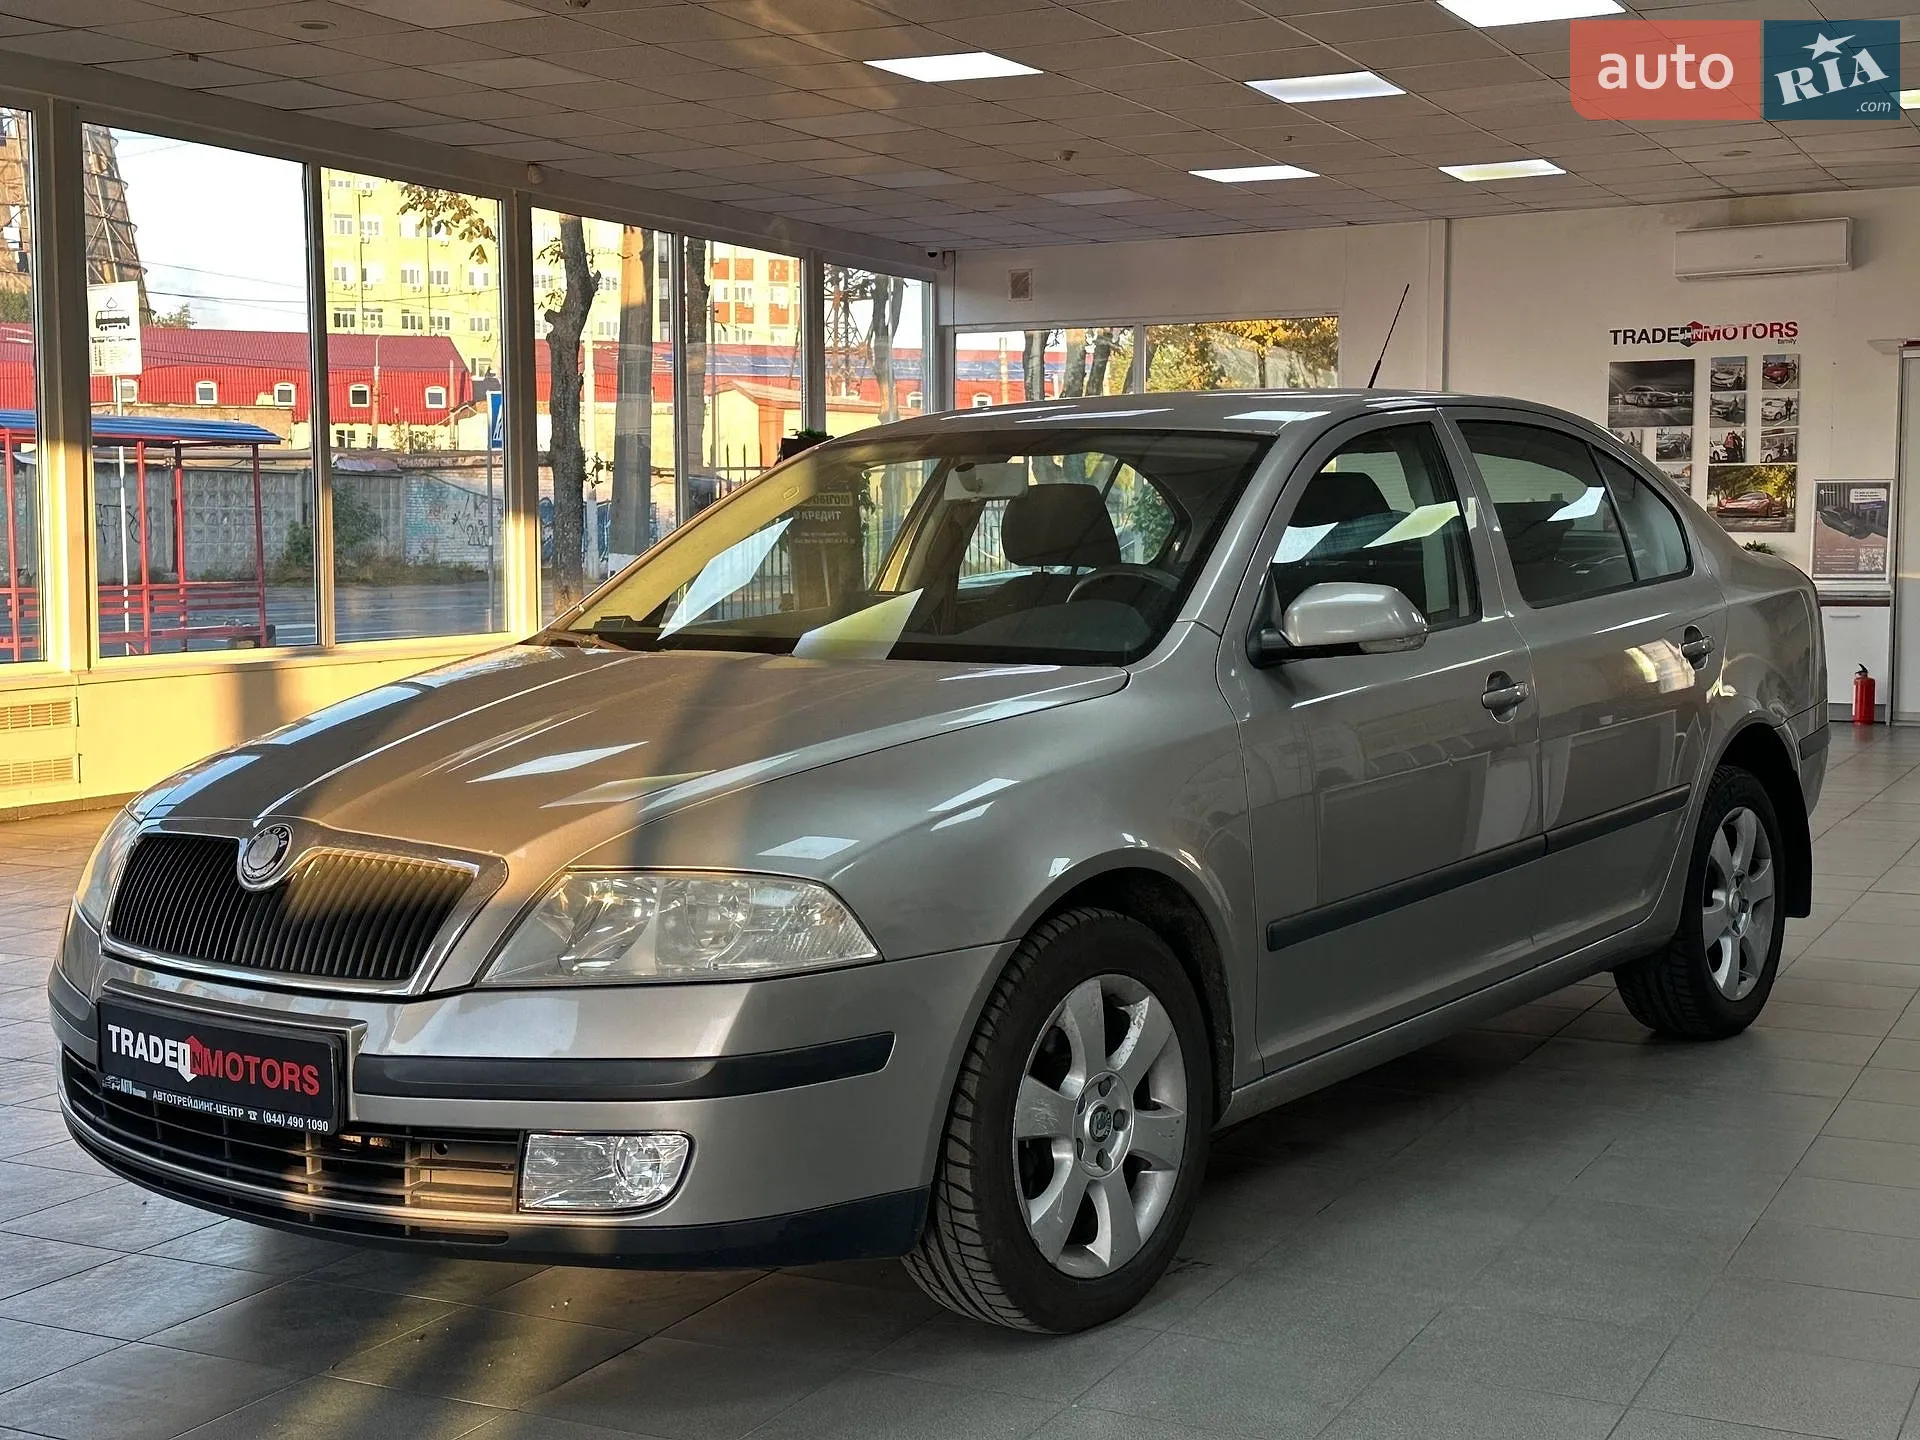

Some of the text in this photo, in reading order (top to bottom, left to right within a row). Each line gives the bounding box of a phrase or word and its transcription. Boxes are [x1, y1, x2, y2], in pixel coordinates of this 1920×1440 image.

[801, 510, 841, 522] КРЕДИТ
[107, 1023, 178, 1070] TRADE
[203, 1047, 320, 1096] MOTORS
[152, 1090, 329, 1132] АВТОТРЕЙДИНГ-ЦЕНТР (044) 490 1090
